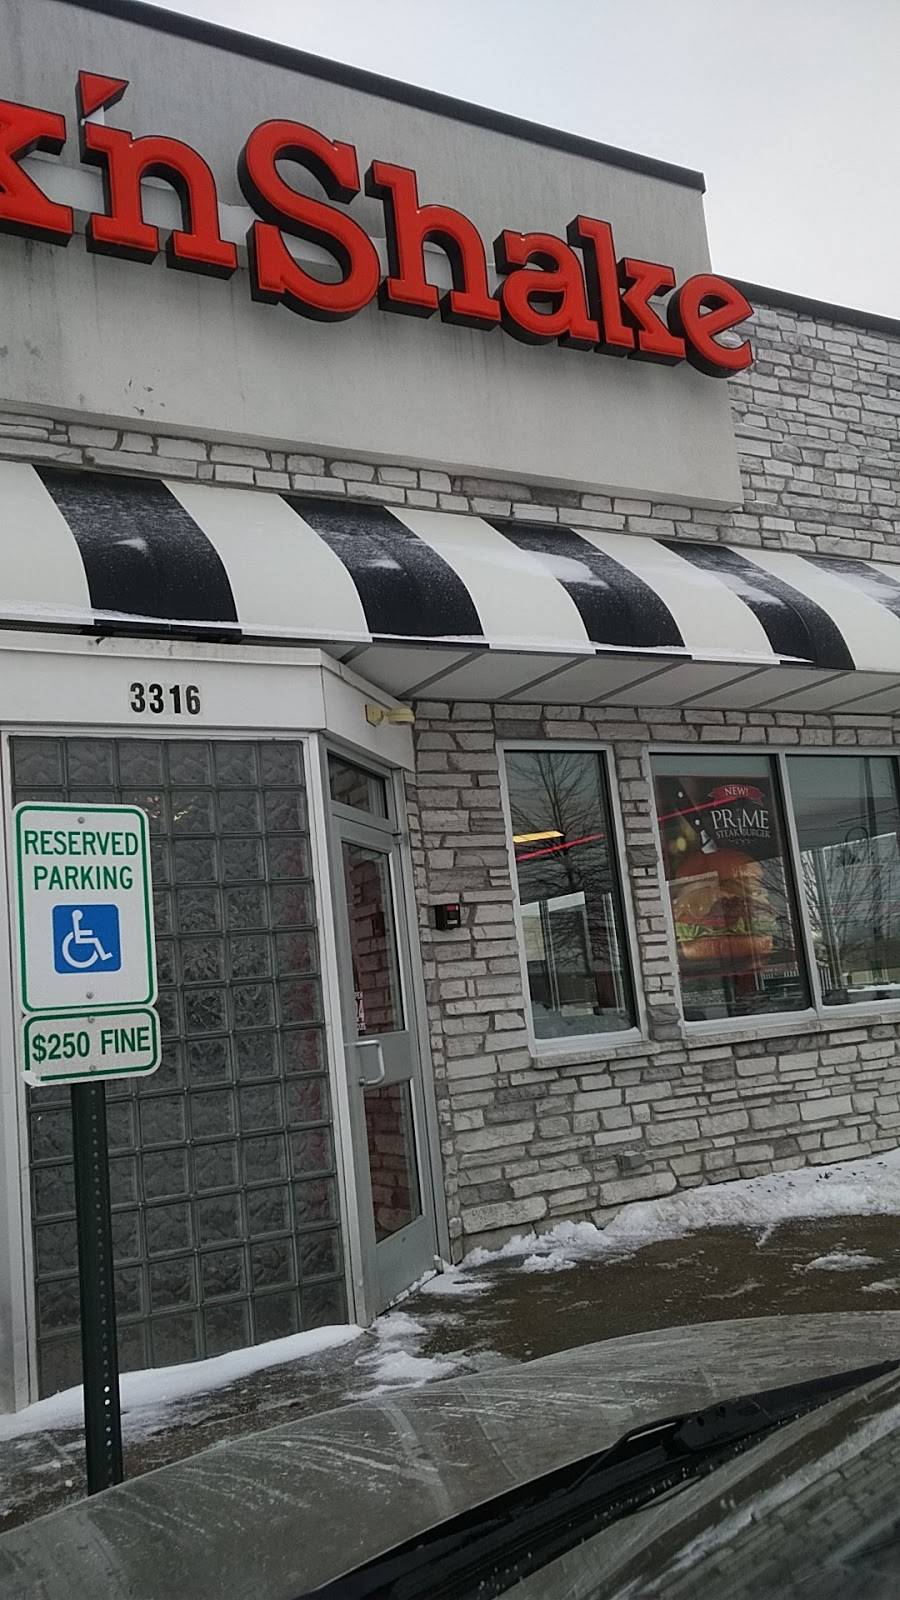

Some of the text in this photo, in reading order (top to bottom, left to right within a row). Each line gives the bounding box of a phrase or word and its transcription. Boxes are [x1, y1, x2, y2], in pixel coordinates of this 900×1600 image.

[129, 682, 201, 715] 3316
[724, 787, 750, 797] NEW!
[24, 830, 139, 856] RESERVED
[33, 865, 134, 891] PARKING
[31, 1026, 151, 1064] $250 FINE
